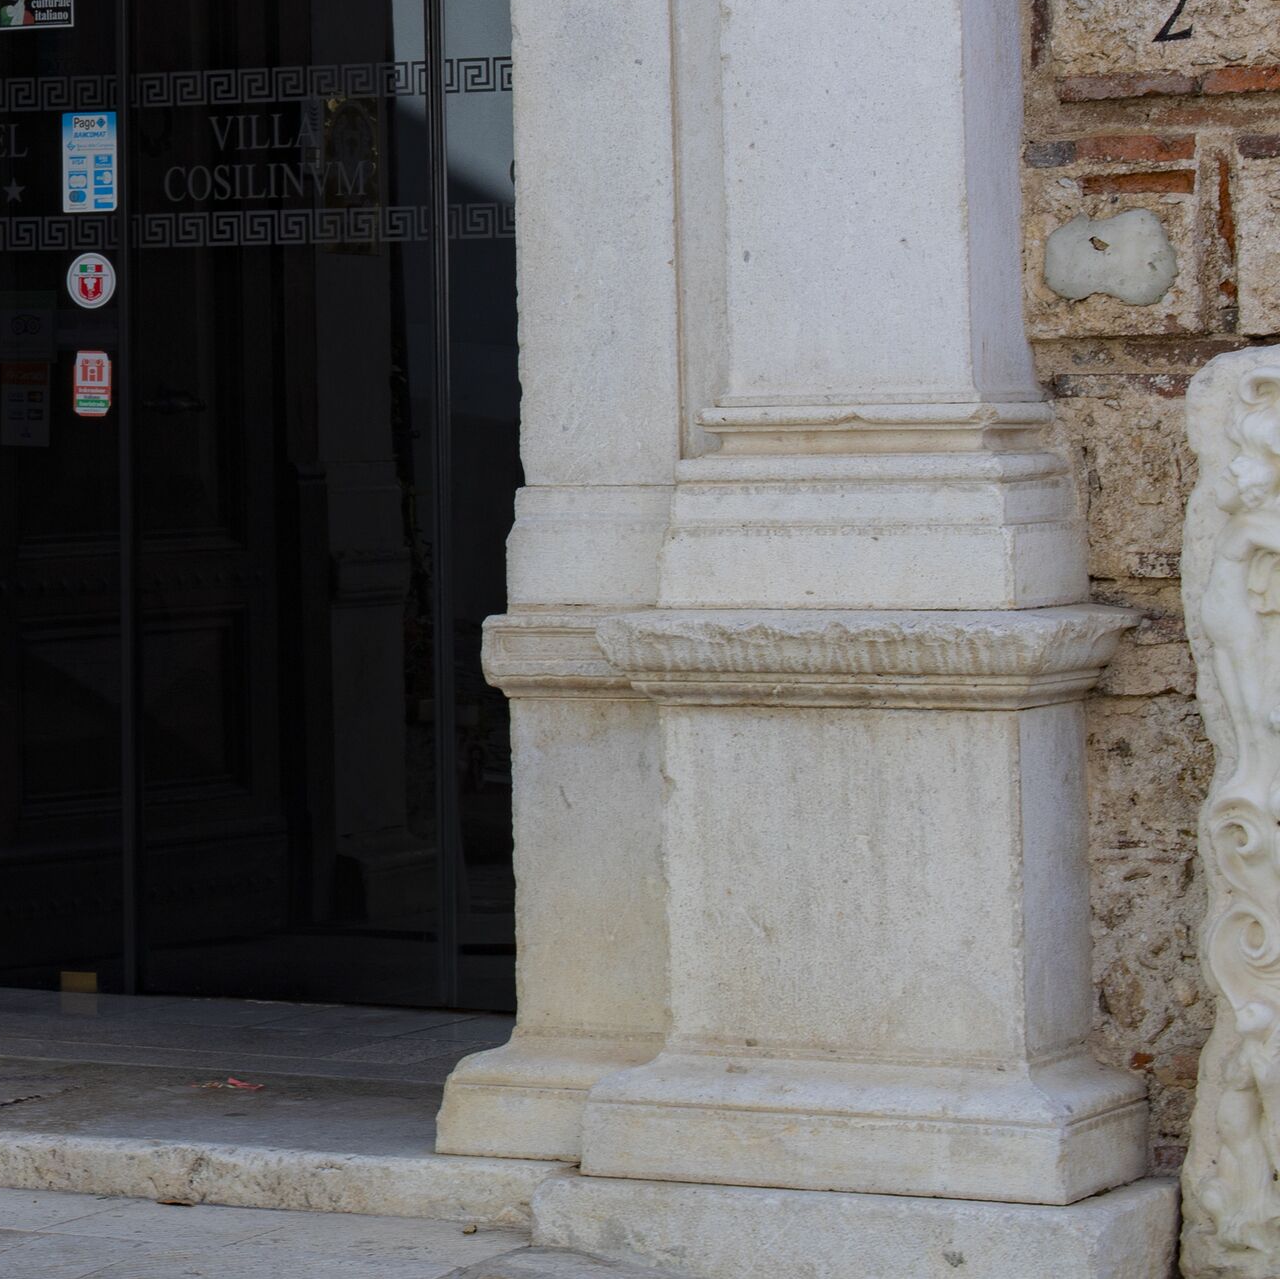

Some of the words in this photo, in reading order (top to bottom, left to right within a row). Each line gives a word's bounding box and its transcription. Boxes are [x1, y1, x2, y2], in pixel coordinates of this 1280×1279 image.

[34, 9, 69, 21] italiano
[73, 117, 96, 130] Pago
[207, 113, 321, 152] VILLA
[163, 160, 369, 203] COSILINVM
